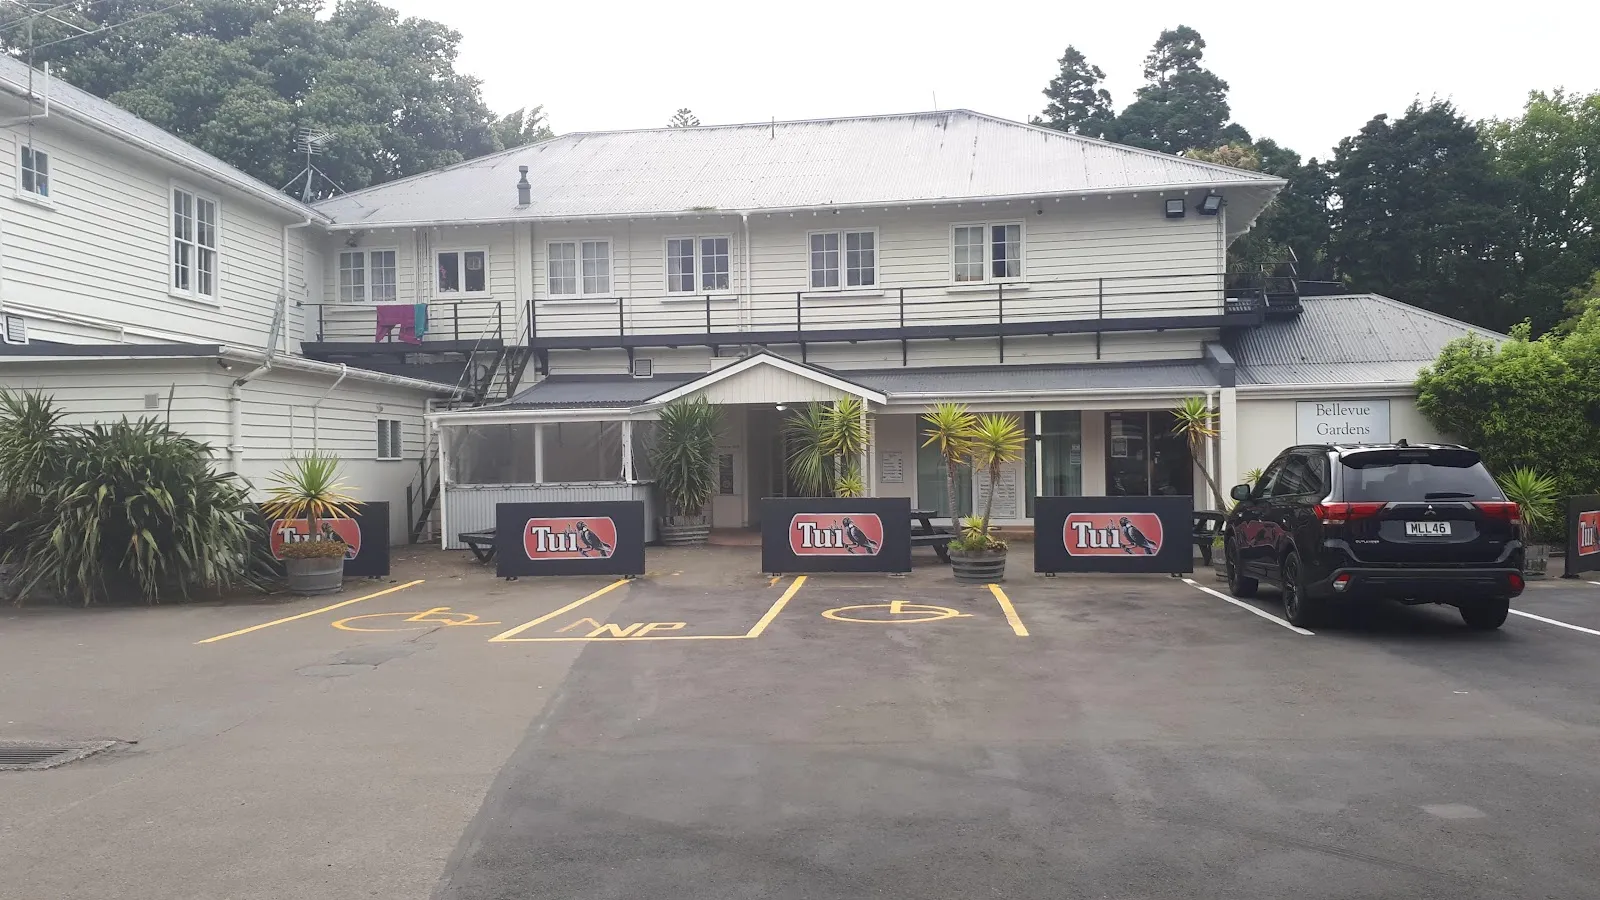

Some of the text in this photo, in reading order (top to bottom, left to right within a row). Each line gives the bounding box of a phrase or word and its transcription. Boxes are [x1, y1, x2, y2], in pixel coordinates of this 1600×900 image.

[1315, 402, 1371, 417] Bellevue
[1316, 421, 1371, 436] Gardens
[797, 521, 845, 548] Tui
[1071, 520, 1121, 548] Tui
[1411, 523, 1446, 534] MLL46
[531, 525, 579, 552] Tui
[584, 622, 687, 638] NP
